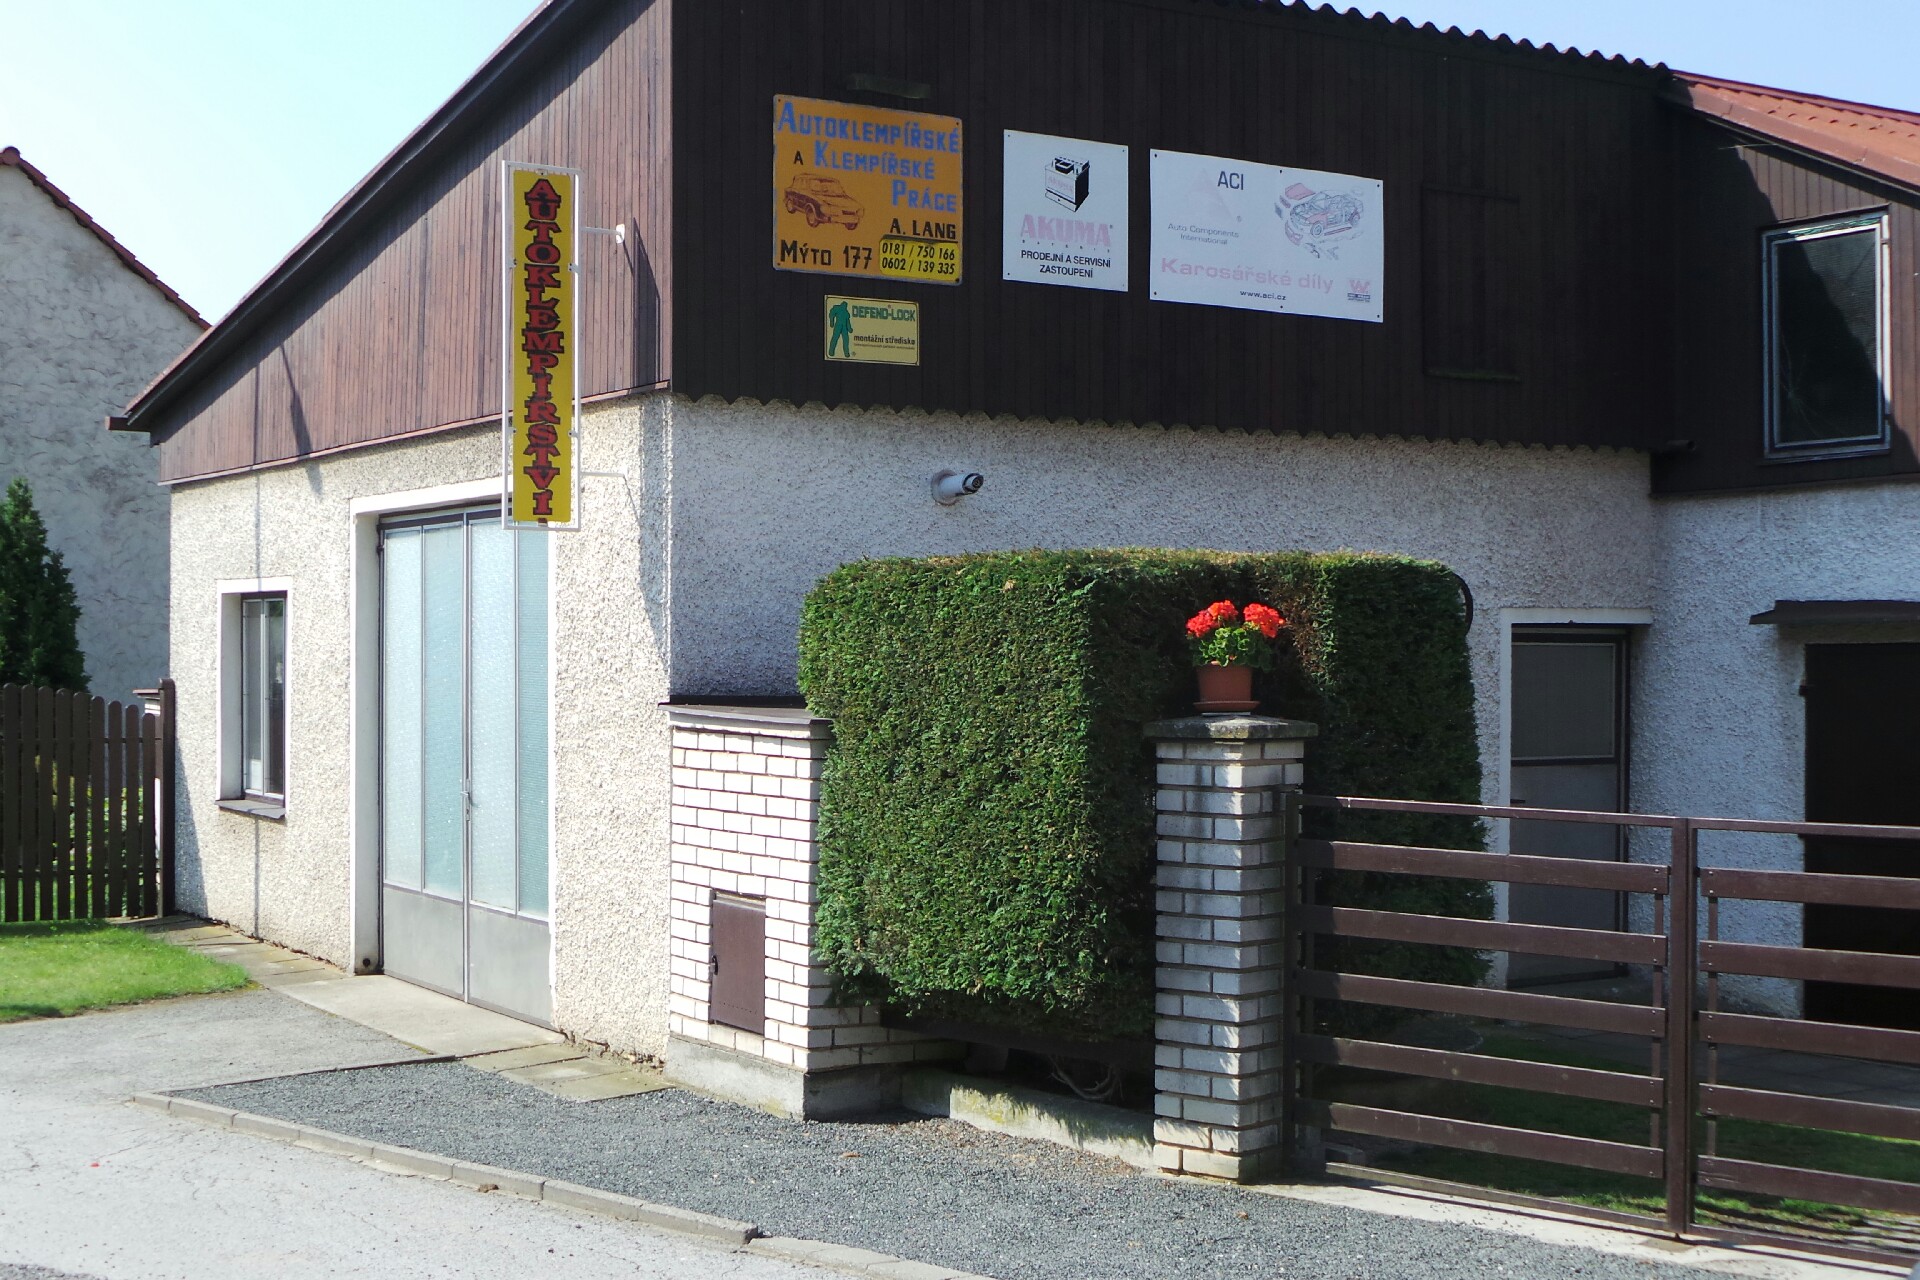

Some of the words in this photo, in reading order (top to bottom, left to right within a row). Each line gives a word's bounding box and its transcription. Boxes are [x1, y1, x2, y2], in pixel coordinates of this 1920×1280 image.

[778, 101, 960, 153] AUTOKLEMPÍŘSKÉ
[793, 151, 804, 165] A
[814, 140, 935, 180] KLEMPÍŘSKÉ
[1217, 170, 1244, 190] ACI
[891, 179, 957, 213] PRÁCE
[889, 217, 906, 235] A.
[912, 219, 957, 239] LANG
[1020, 214, 1111, 247] AKUMA
[1167, 223, 1187, 232] Auto
[1189, 225, 1240, 238] Components
[1180, 233, 1228, 245] International
[780, 239, 832, 266] MÝTO
[843, 245, 873, 270] 177
[882, 242, 905, 256] 0181
[917, 246, 935, 259] 750
[938, 247, 955, 261] 166
[1021, 249, 1064, 263] PRODEJNÍ
[1065, 254, 1072, 264] A
[1073, 255, 1111, 268] SERVISNÍ
[882, 257, 905, 271] 0602
[917, 260, 935, 273] 139
[937, 261, 955, 275] 335
[1039, 264, 1093, 278] ZASTOUPENÍ
[1161, 257, 1292, 287] Karosářské
[1298, 273, 1334, 294] díly
[1239, 290, 1287, 301] www.aci.cz
[852, 305, 916, 322] DEFEND-LOCK
